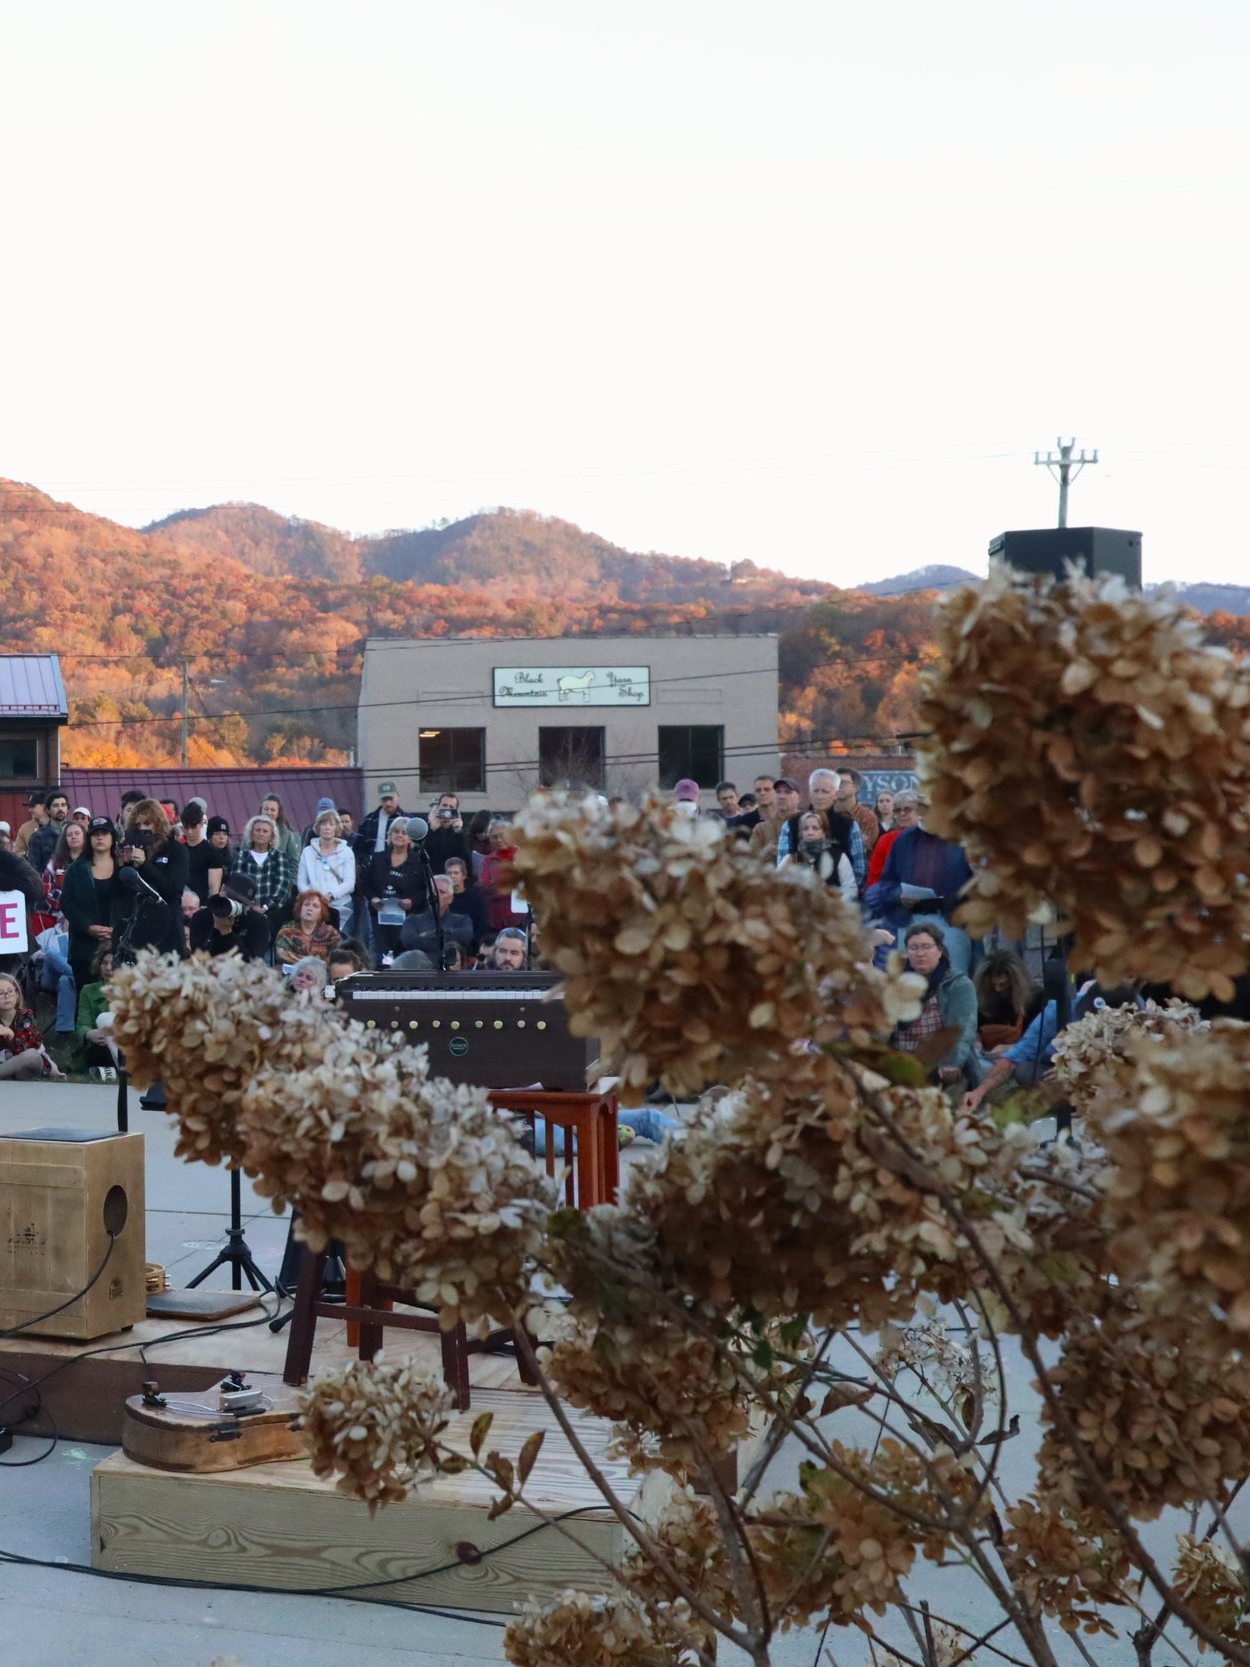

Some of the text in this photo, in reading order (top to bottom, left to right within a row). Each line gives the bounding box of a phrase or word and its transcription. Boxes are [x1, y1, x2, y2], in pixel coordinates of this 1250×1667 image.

[514, 671, 544, 684] Black
[606, 671, 632, 687] Yarn
[499, 685, 548, 698] Mountain
[618, 685, 645, 702] Shop
[862, 775, 920, 791] YSON
